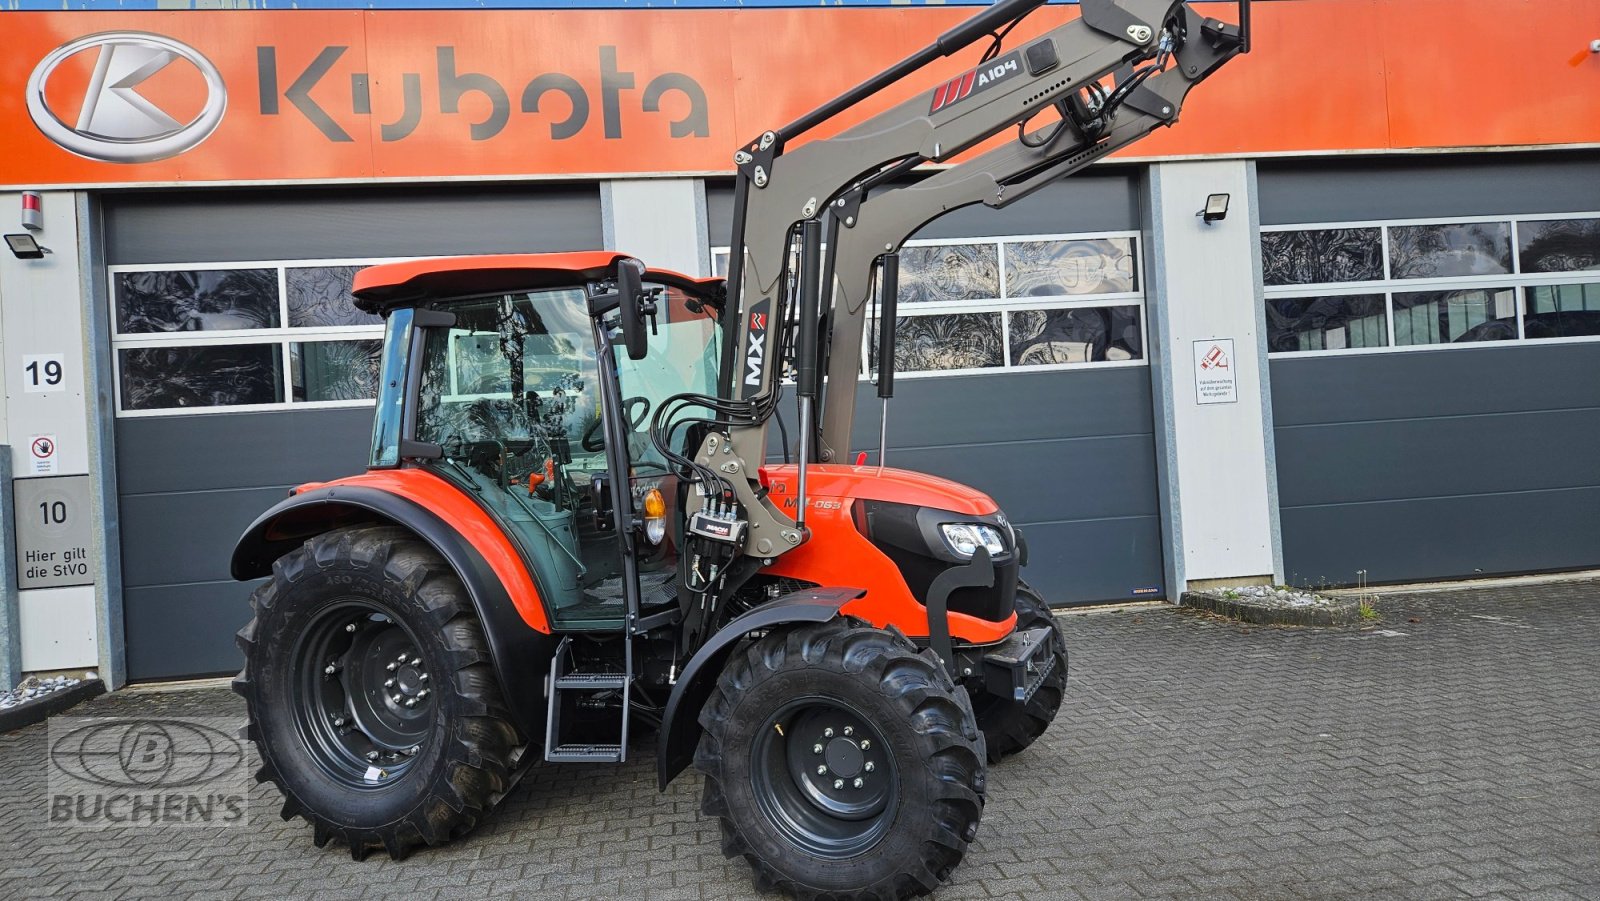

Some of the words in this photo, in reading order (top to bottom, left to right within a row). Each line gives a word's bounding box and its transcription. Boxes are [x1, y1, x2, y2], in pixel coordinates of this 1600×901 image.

[978, 59, 1018, 87] A104
[256, 45, 710, 142] Kubota
[26, 360, 62, 385] 19
[39, 501, 67, 525] 10
[26, 551, 56, 563] Hier
[63, 548, 87, 563] gilt
[26, 567, 48, 579] die
[53, 563, 88, 577] StVO
